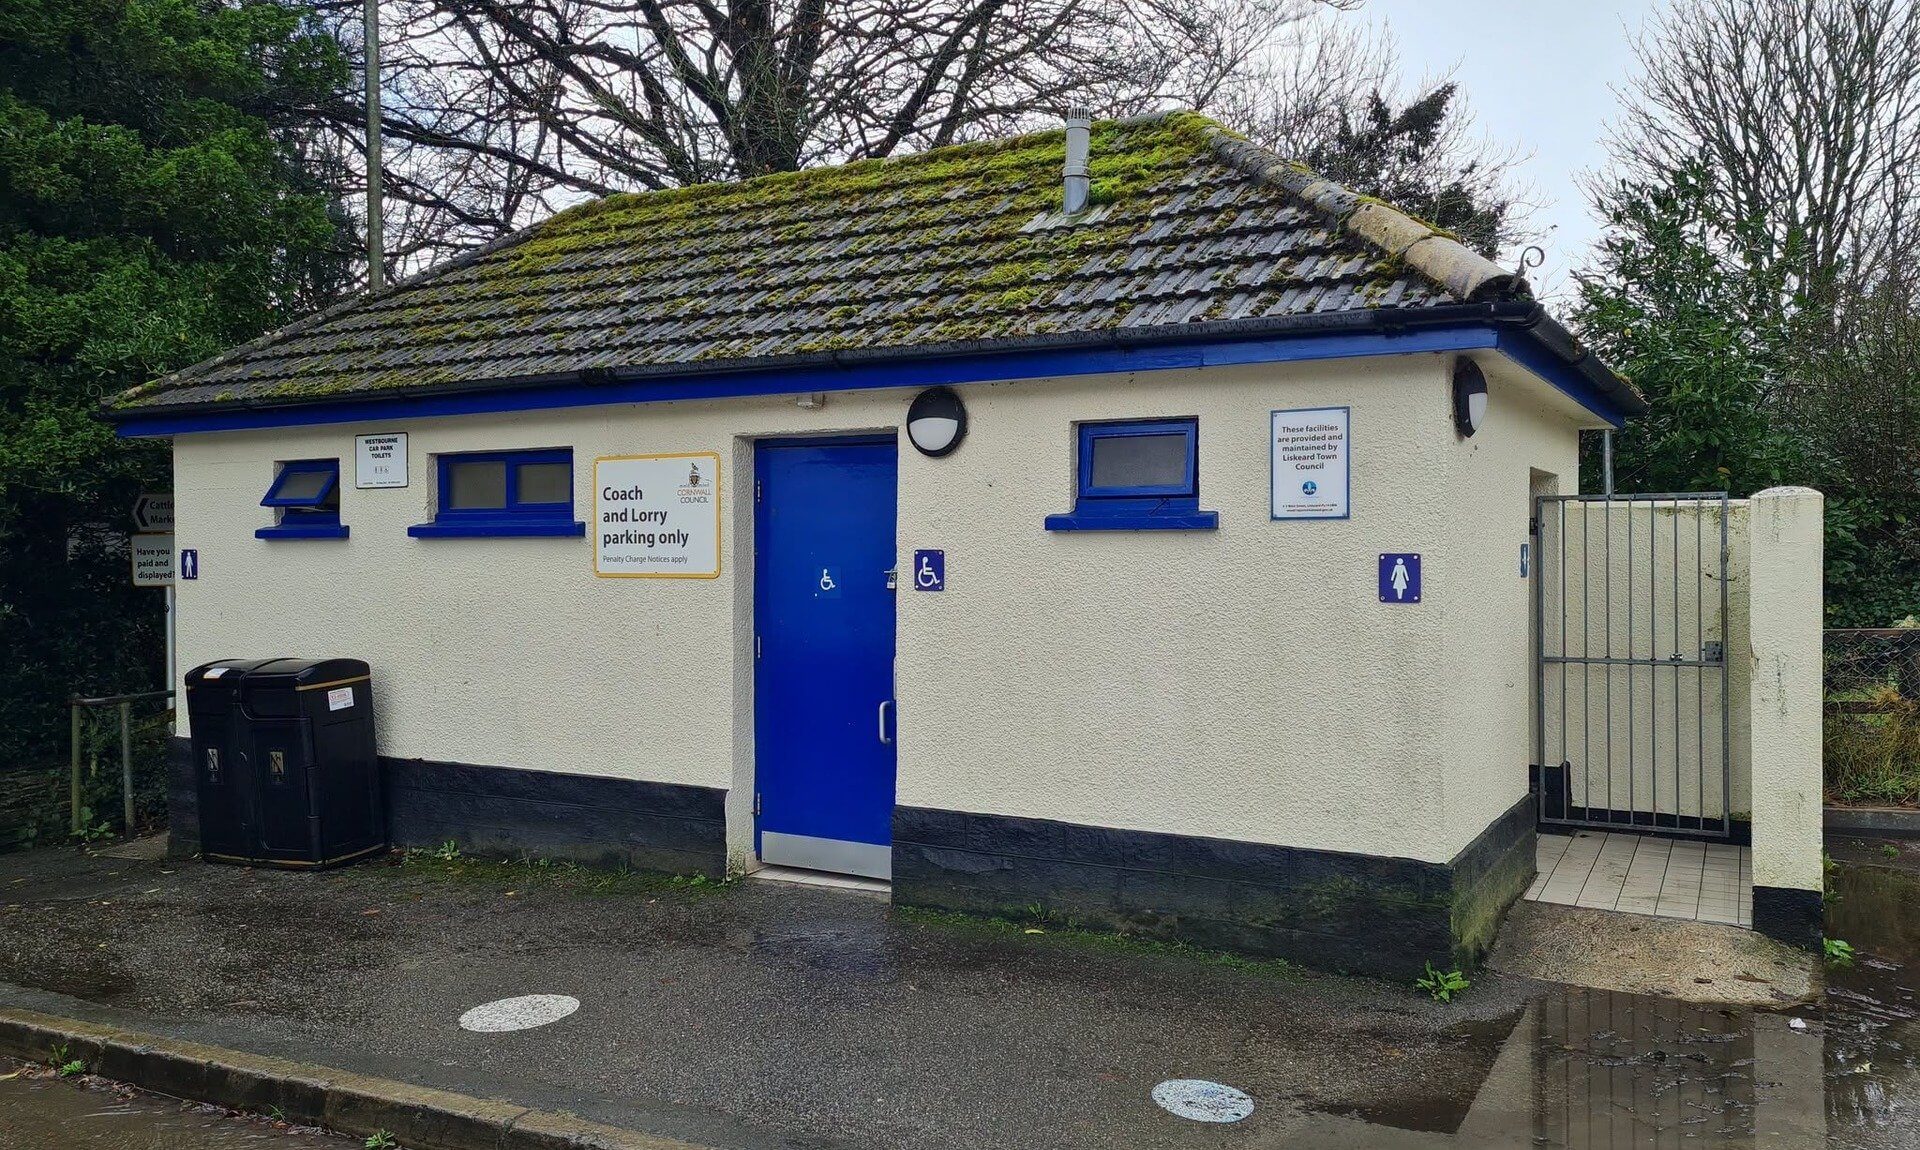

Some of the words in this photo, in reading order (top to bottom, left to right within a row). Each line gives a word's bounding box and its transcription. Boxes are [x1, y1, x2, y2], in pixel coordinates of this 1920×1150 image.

[1306, 424, 1338, 432] facilities
[1291, 434, 1326, 444] provided
[1282, 444, 1326, 452] maintained
[1328, 443, 1338, 452] by
[1282, 454, 1315, 462] Liskeard
[603, 486, 643, 500] Coach
[603, 508, 628, 522] and
[632, 508, 668, 526] Lorry
[604, 530, 654, 548] parking
[658, 529, 689, 548] only
[138, 560, 154, 569] paid
[603, 556, 624, 564] Penalty
[625, 556, 646, 564] Charge
